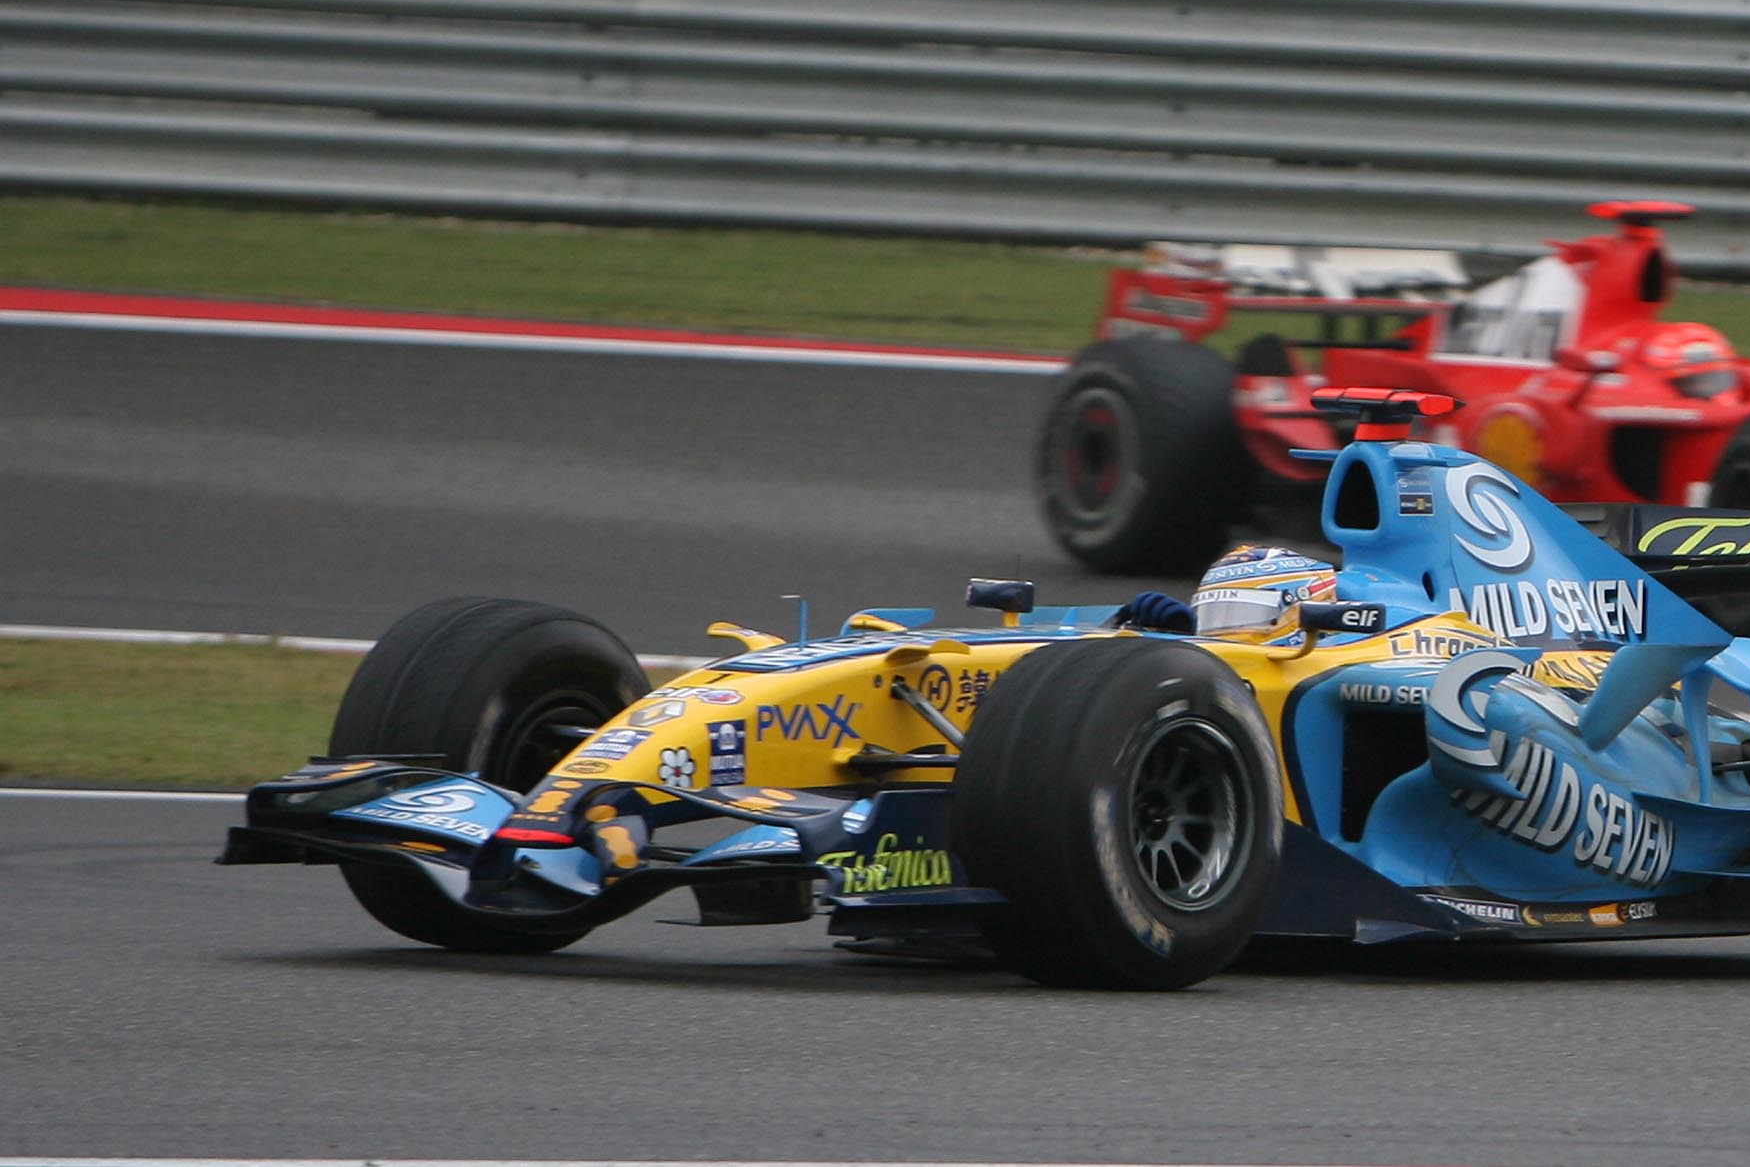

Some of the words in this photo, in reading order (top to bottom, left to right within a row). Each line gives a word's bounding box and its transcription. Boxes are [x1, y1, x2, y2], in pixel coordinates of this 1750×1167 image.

[1342, 610, 1379, 627] elf
[1449, 581, 1548, 638] MILD
[1546, 579, 1645, 636] SEVEN
[1339, 684, 1391, 703] MILD
[1449, 730, 1581, 847] MILD
[1575, 783, 1675, 887] SEVEN
[411, 814, 490, 839] SEVEN
